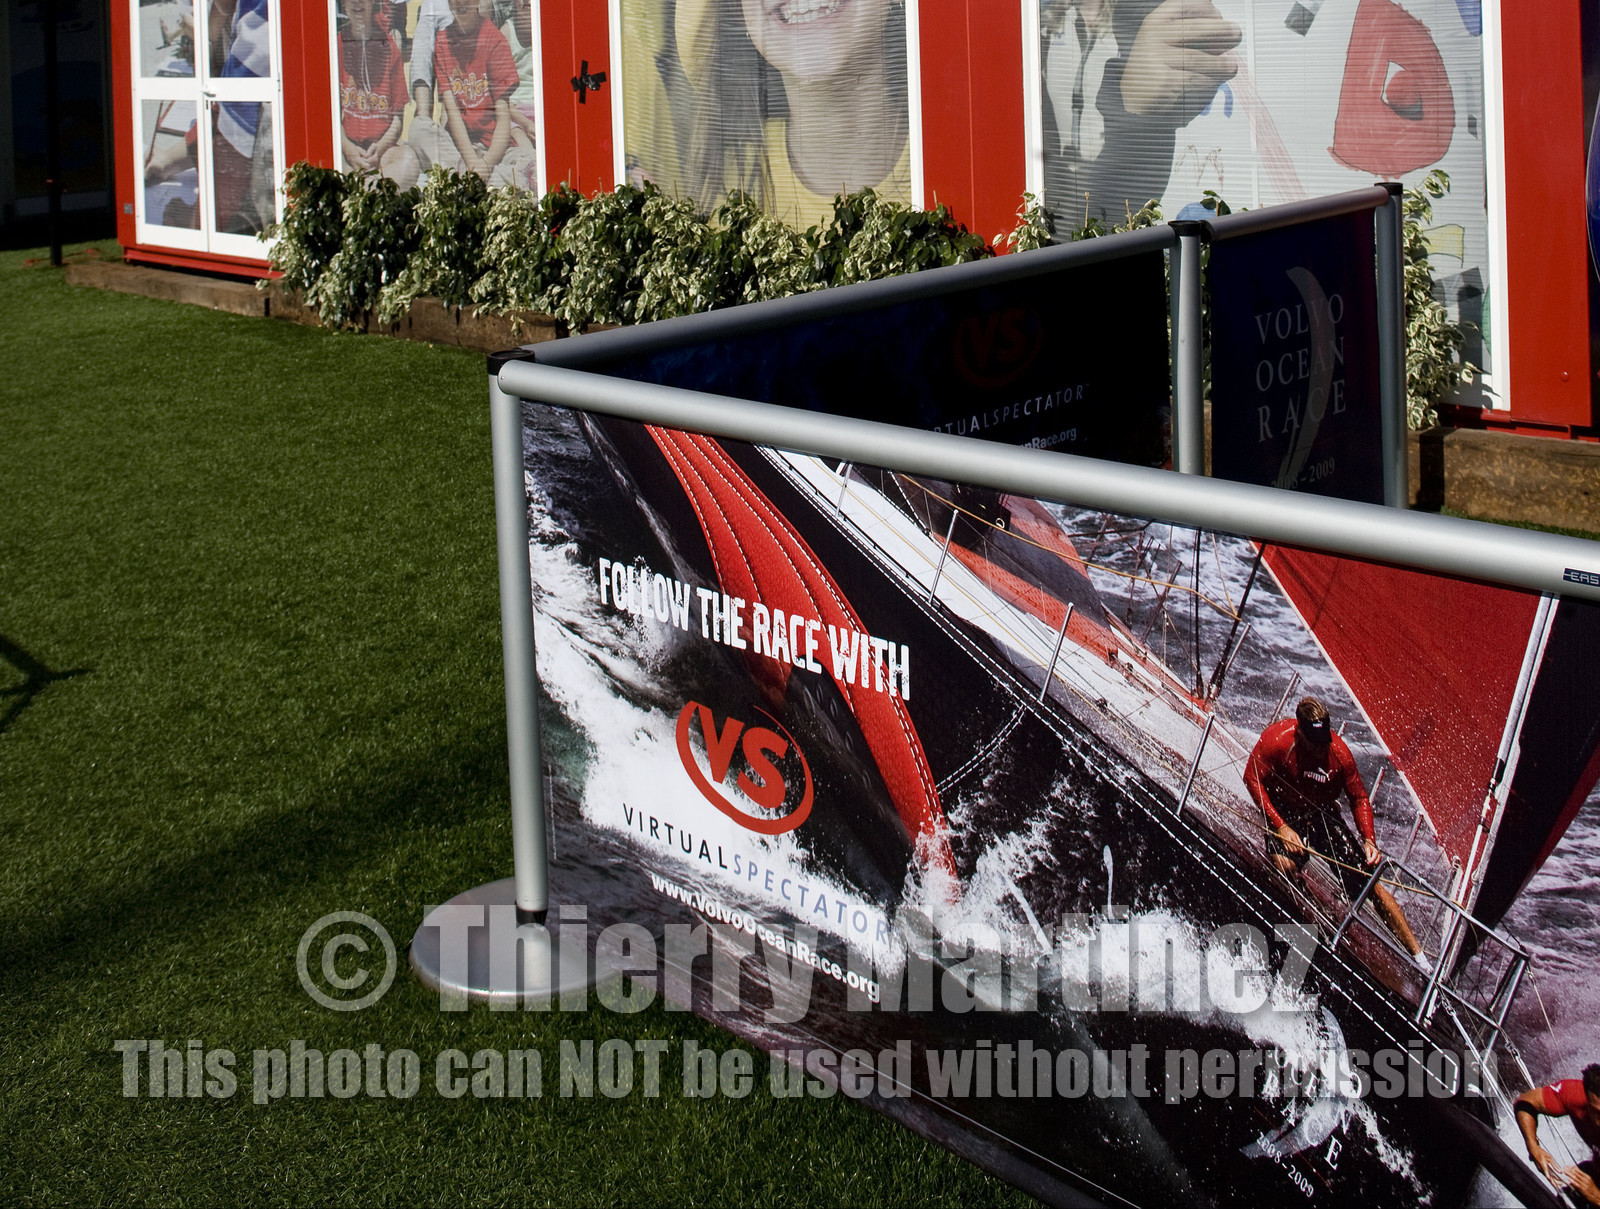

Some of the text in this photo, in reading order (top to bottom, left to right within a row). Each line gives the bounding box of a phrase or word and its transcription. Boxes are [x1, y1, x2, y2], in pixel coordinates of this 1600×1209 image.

[1254, 292, 1345, 345] VOLVO
[1255, 335, 1345, 393] OCEAN
[1256, 377, 1347, 443] RACE
[599, 555, 910, 701] FOLLOW THE RACE WITH
